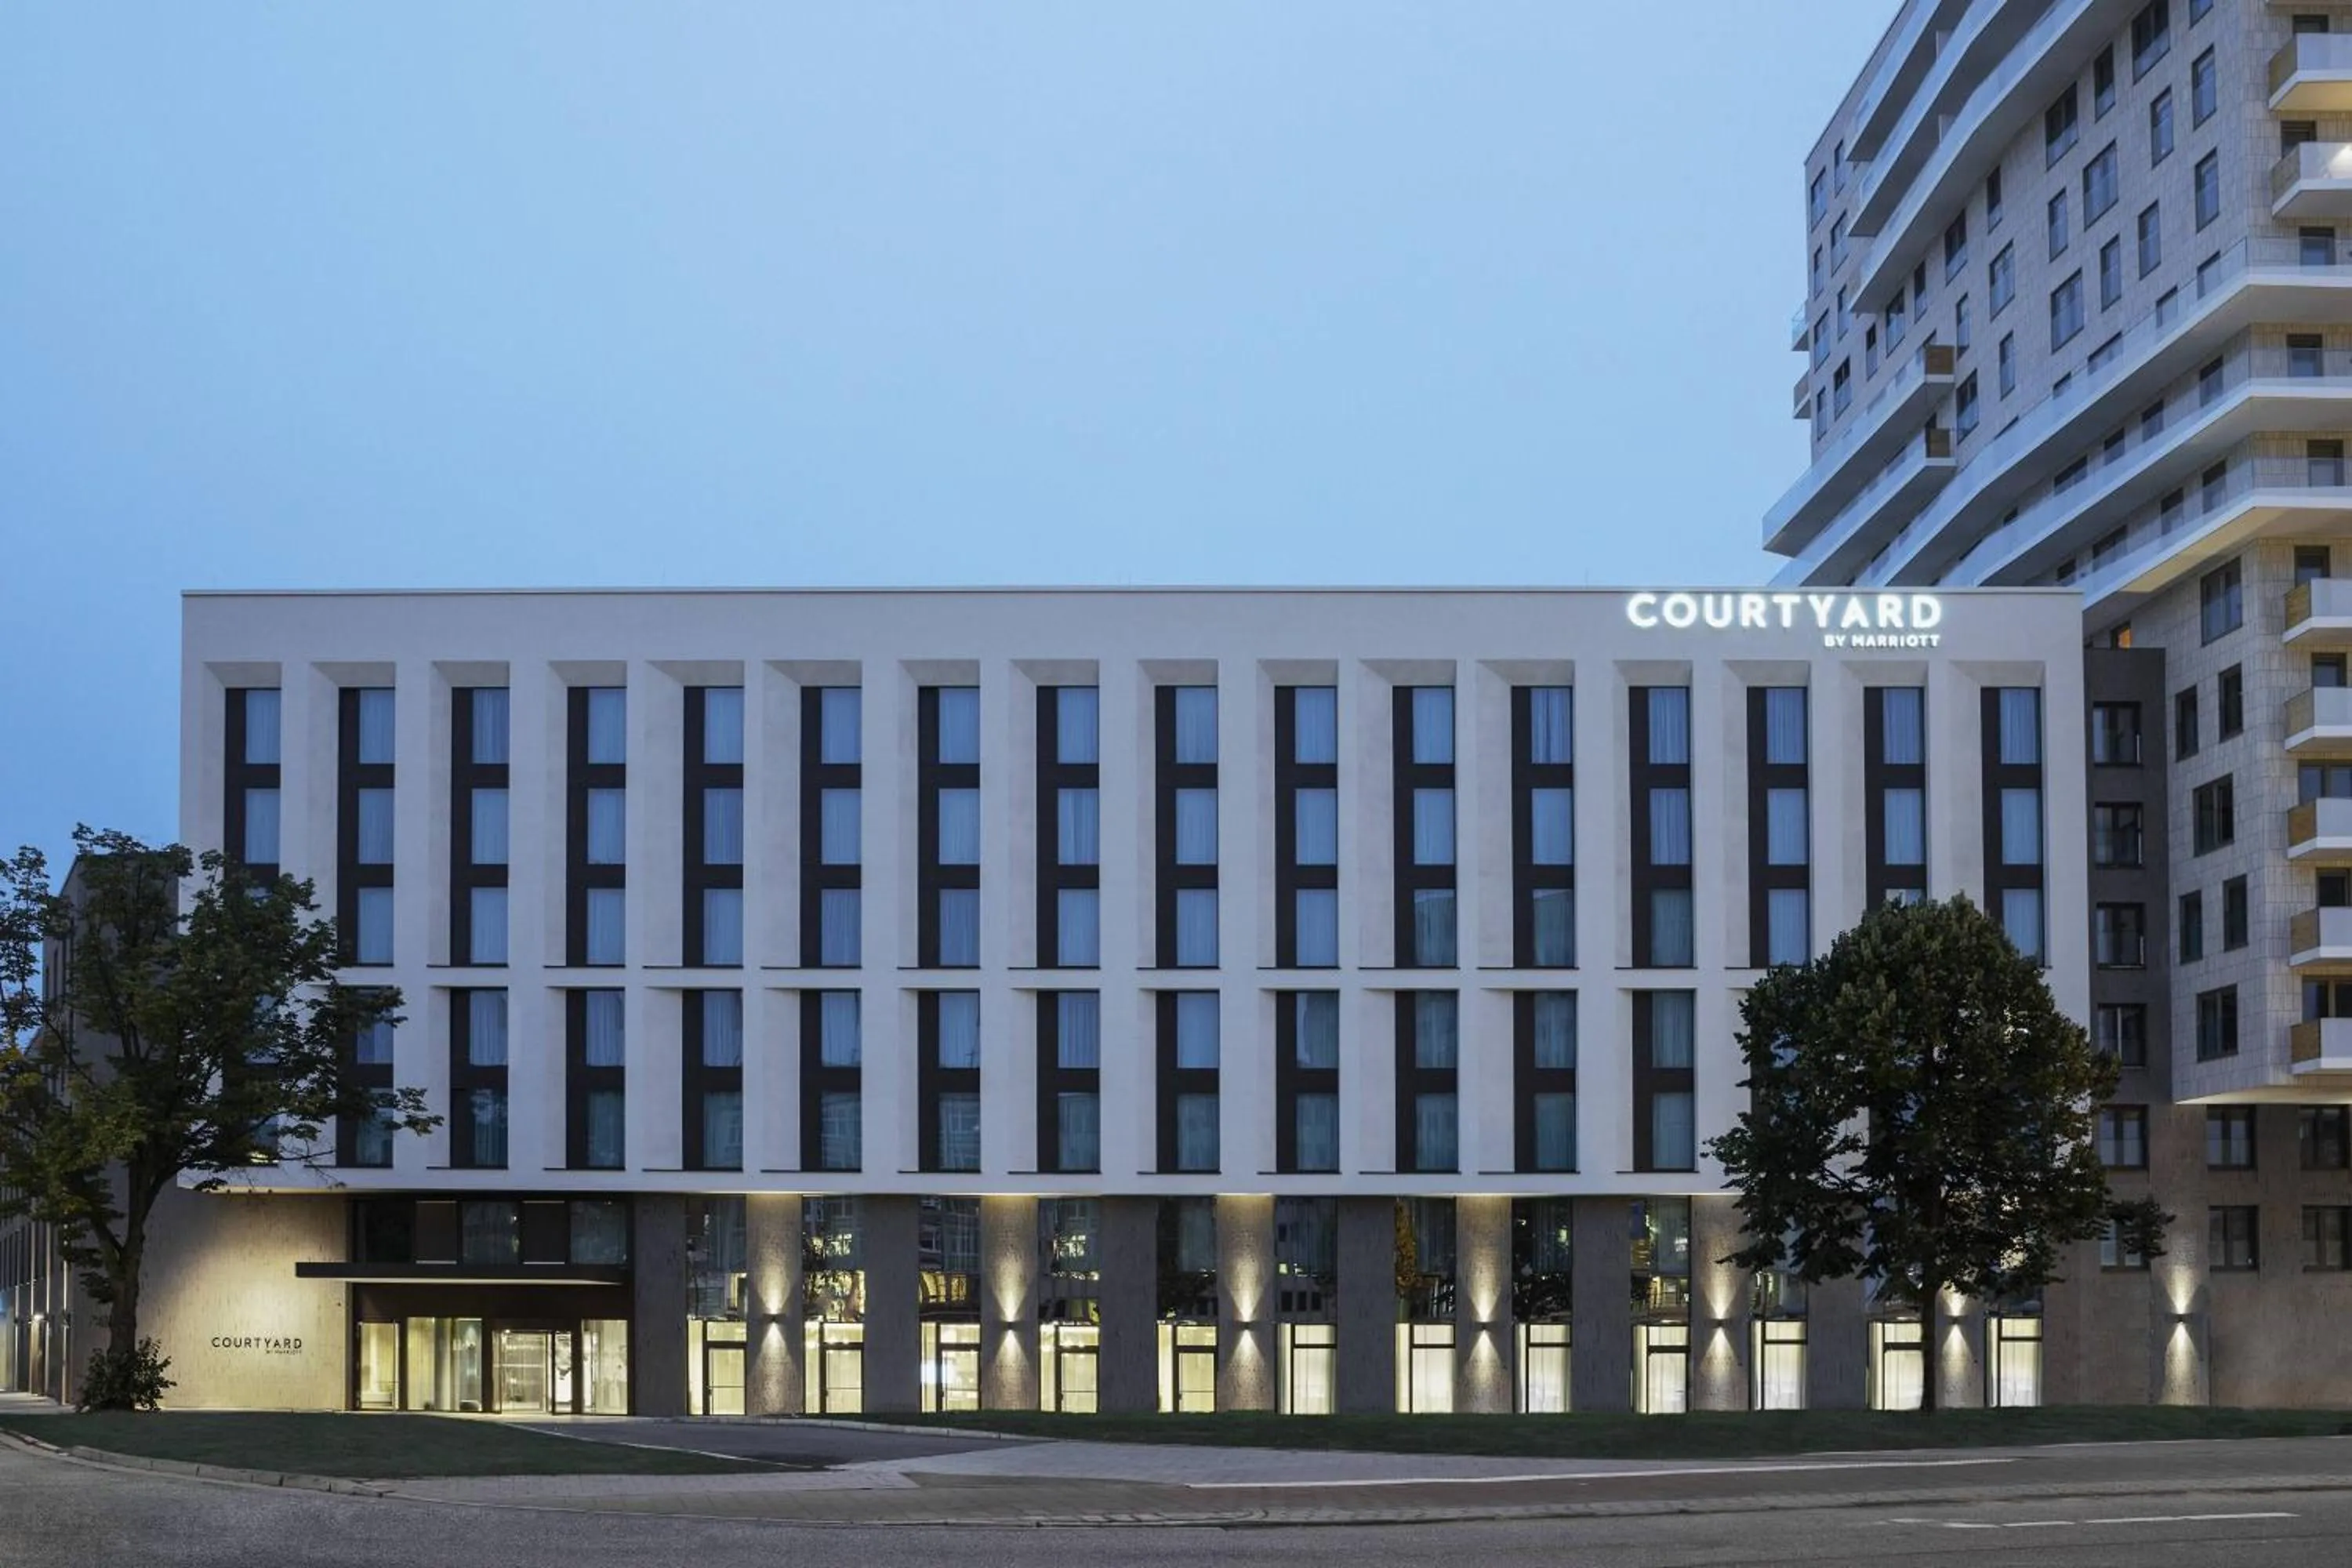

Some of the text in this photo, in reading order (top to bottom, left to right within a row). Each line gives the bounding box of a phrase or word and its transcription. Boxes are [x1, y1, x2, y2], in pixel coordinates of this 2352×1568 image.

[1627, 593, 1942, 628] COURTYARD
[1824, 633, 1940, 648] BY MARRIOTT
[212, 1337, 302, 1349] COURTYARD
